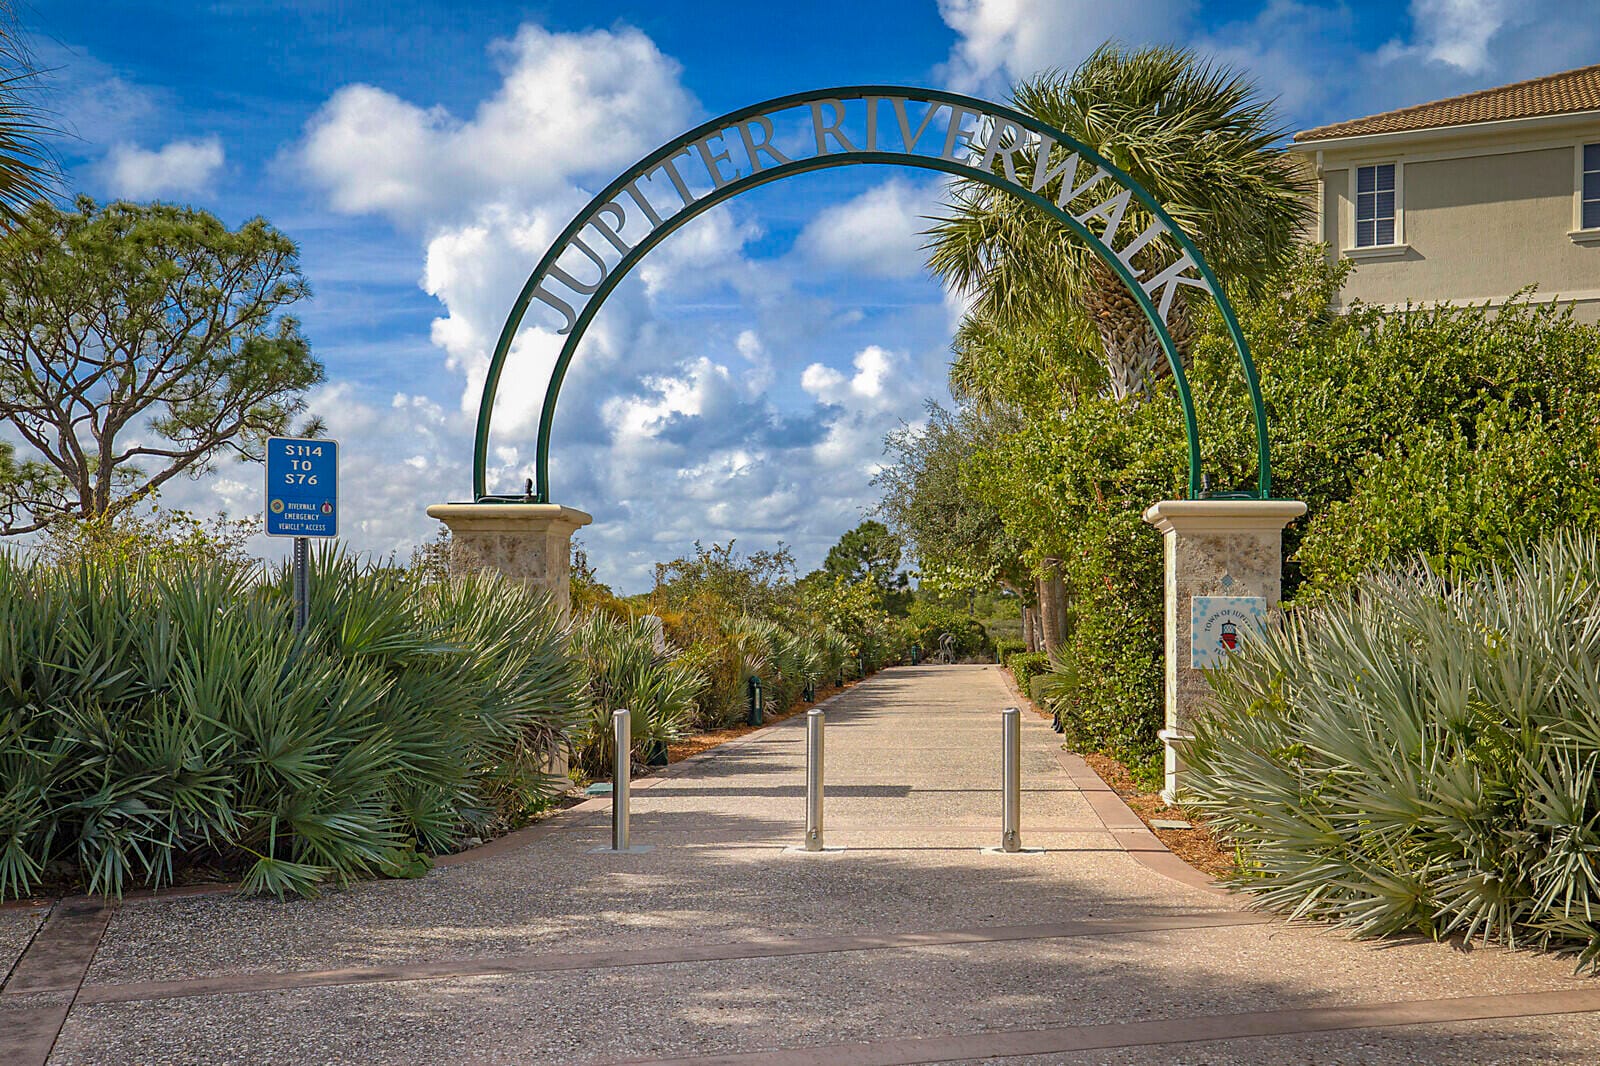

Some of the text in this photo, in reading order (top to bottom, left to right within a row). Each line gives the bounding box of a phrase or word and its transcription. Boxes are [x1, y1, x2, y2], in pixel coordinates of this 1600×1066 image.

[527, 95, 1214, 335] JUPITER RIVERWALK
[285, 445, 322, 457] S114
[291, 460, 312, 471] TO
[285, 474, 318, 485] S76
[288, 502, 316, 510] RIVERWALK
[284, 512, 320, 520] EMERGENCY
[278, 523, 300, 531] VEHICLE
[1204, 612, 1220, 632] TOWN
